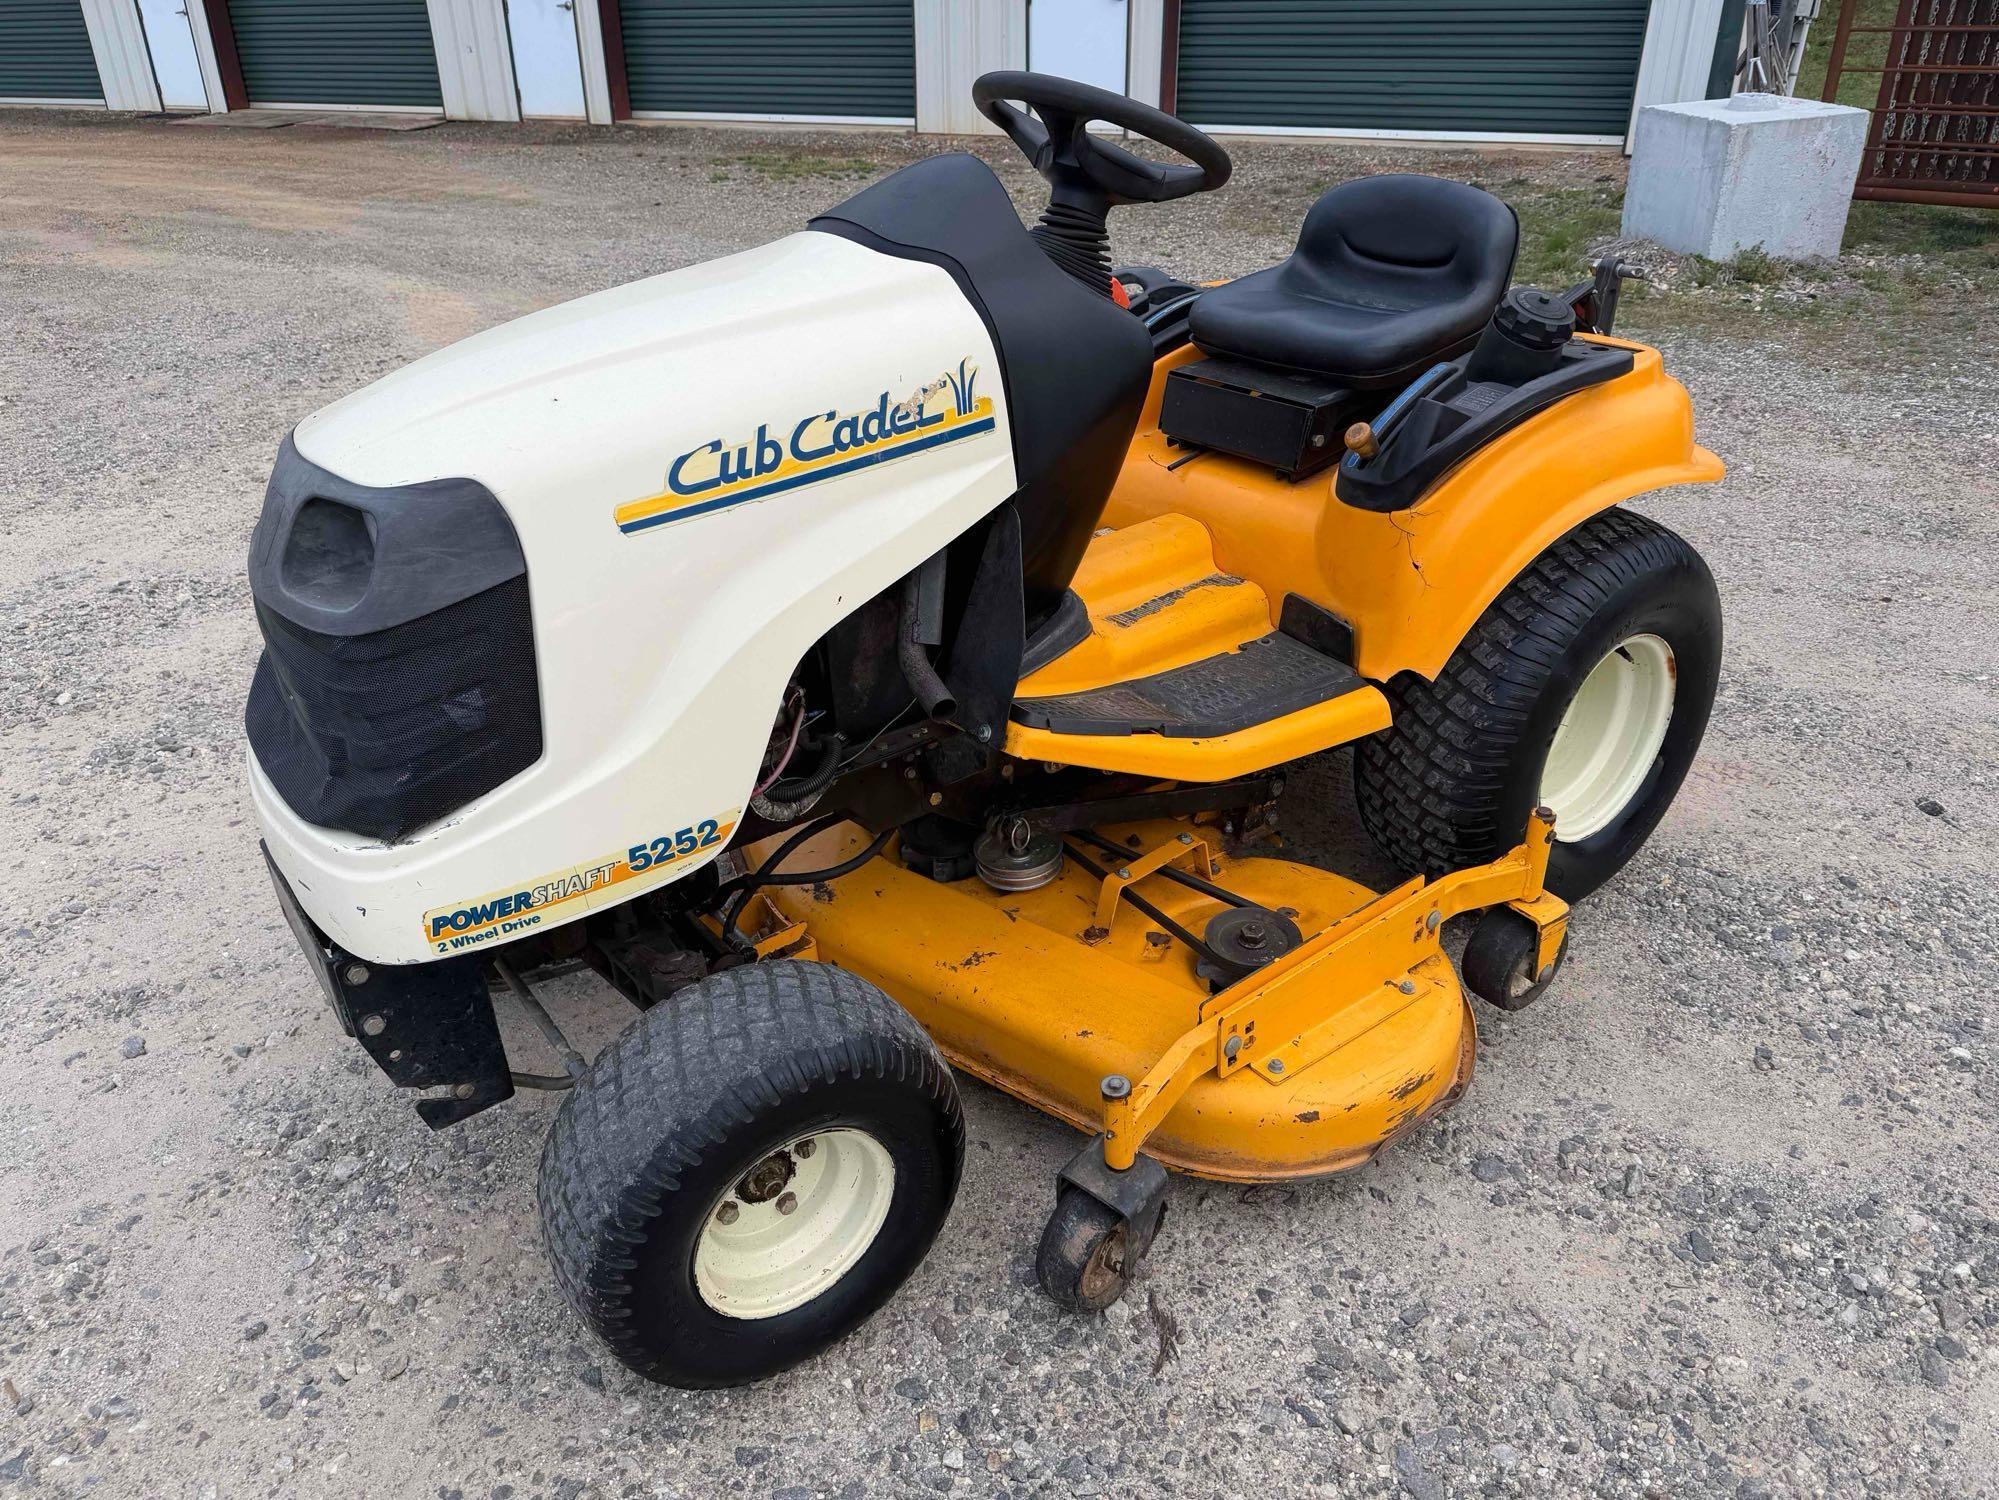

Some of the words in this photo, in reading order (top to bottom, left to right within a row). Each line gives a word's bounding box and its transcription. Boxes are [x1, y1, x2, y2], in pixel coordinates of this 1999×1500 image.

[668, 424, 783, 496] Cub
[628, 819, 722, 872] 5252
[437, 942, 449, 953] 2
[450, 927, 499, 949] Wheel
[503, 914, 541, 934] Drive
